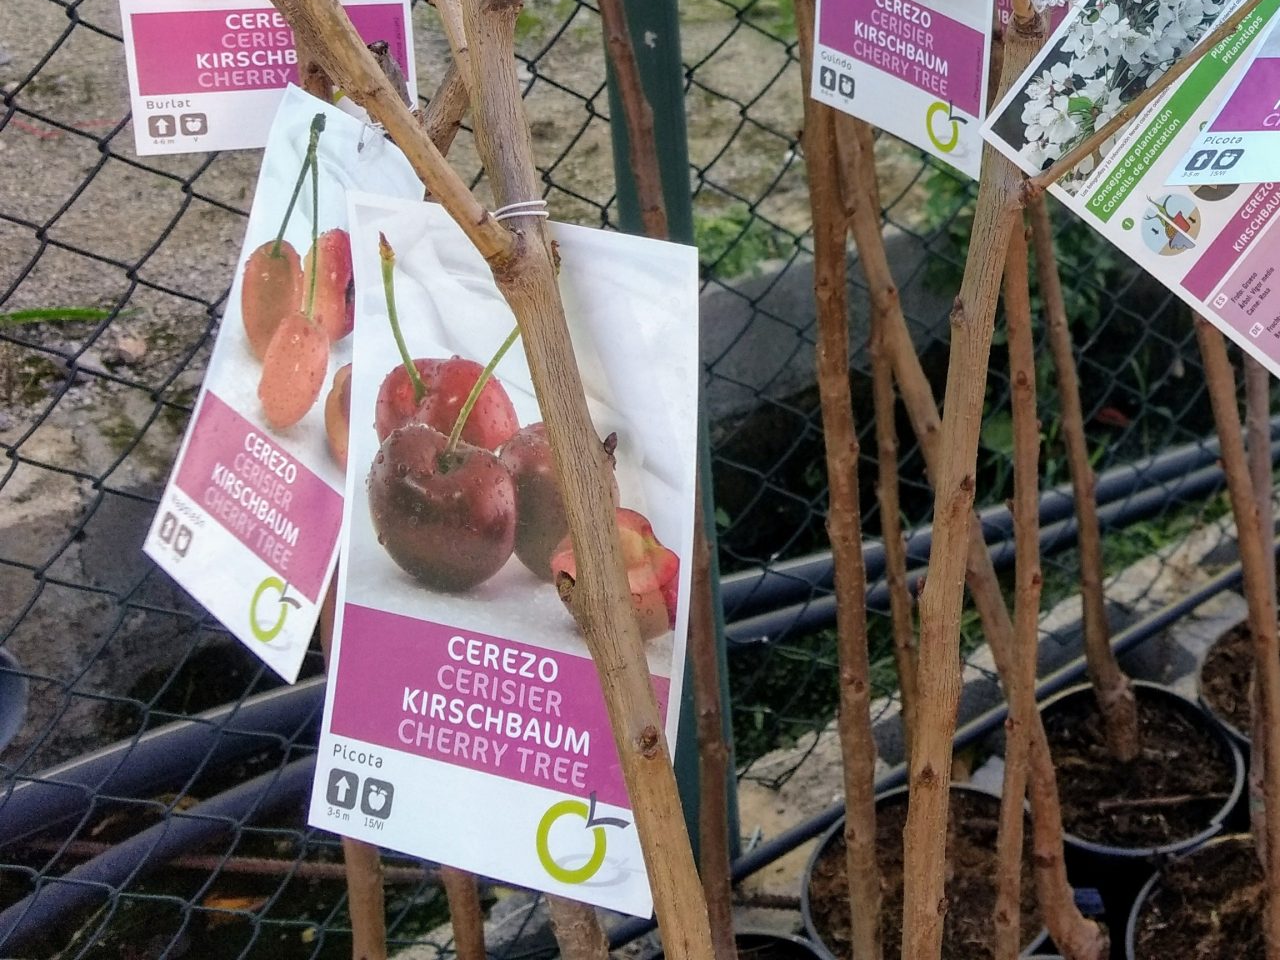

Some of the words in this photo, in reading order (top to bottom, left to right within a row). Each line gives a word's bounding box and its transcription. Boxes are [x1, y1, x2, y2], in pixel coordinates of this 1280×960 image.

[224, 12, 290, 30] CERE
[870, 6, 934, 51] CERISIER
[1220, 14, 1265, 64] Pflanztipps
[195, 49, 298, 70] KIRSCHB
[820, 47, 852, 72] Guindo
[853, 37, 909, 78] CHERRY
[912, 64, 948, 97] TREE
[854, 18, 948, 78] KIRSCHBAUM
[197, 68, 292, 88] CHERRY
[146, 98, 191, 110] Burlat
[1128, 105, 1175, 157] plantación
[1202, 135, 1244, 144] Picota
[1100, 173, 1136, 213] Conseils
[1129, 160, 1145, 176] de
[1139, 116, 1182, 165] plantation
[1122, 153, 1136, 168] de
[1090, 166, 1128, 208] Consejos
[1238, 179, 1275, 220] CEREZO
[1214, 295, 1225, 306] ES
[1230, 287, 1245, 303] Fruto:
[1241, 271, 1258, 289] Grueso
[1237, 292, 1253, 309] Árbol:
[1249, 280, 1264, 296] Vigor
[1259, 265, 1275, 282] medio
[1245, 298, 1262, 316] Carne:
[1258, 286, 1271, 300] Rosa
[1250, 324, 1261, 336] DE
[242, 428, 298, 488] CEREZO
[231, 448, 293, 513] CERISIER
[210, 459, 300, 549] KIRSCHBAUM
[202, 482, 256, 542] CHERRY
[254, 526, 292, 573] TREE
[446, 633, 559, 685] CEREZO
[435, 662, 563, 718] CERISIER
[401, 685, 590, 757] KIRSCHBAUM
[332, 741, 384, 769] Picota
[396, 716, 508, 770] CHERRY
[515, 746, 588, 789] TREE
[326, 805, 340, 819] 3-5
[363, 816, 384, 831] 15/VI
